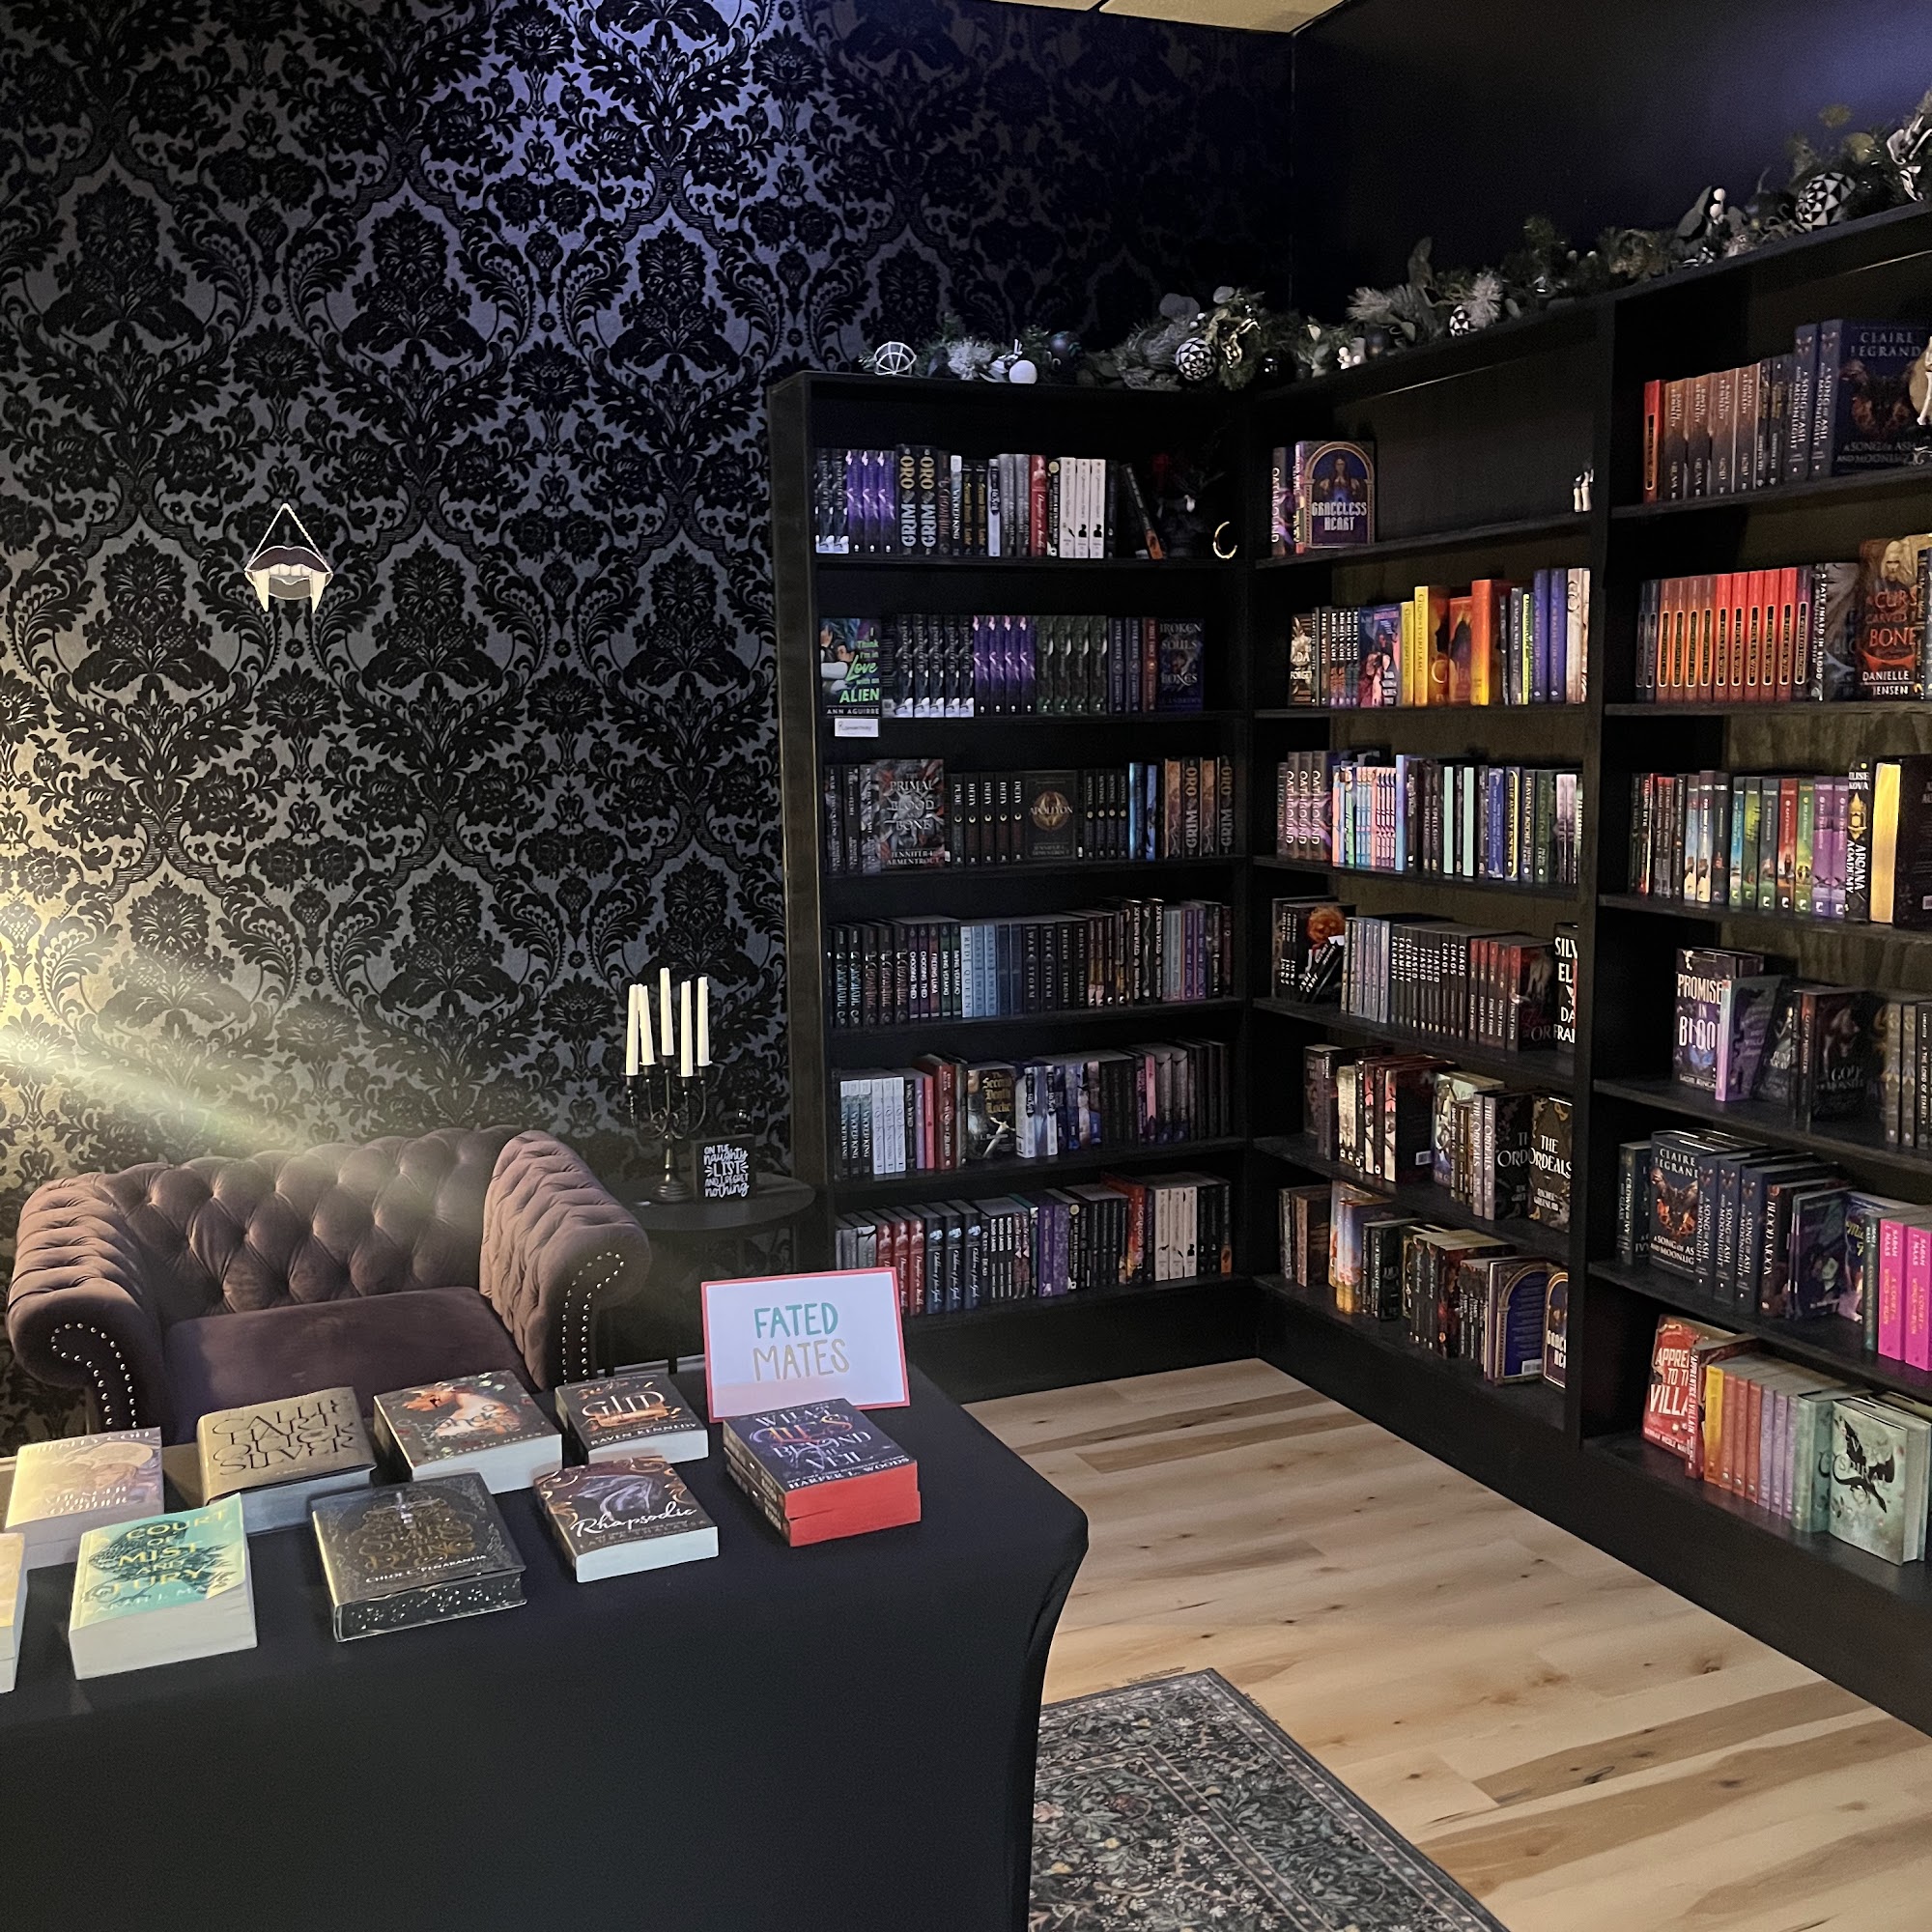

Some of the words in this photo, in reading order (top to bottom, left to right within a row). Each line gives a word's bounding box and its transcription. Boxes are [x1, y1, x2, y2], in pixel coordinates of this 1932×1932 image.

[899, 456, 915, 489] ORO
[920, 456, 935, 490] ORO
[1311, 501, 1367, 516] GRACELESS
[1324, 516, 1354, 530] HEART
[901, 503, 917, 547] GRIM
[921, 503, 937, 548] GRIM
[1870, 628, 1916, 647] BONE
[845, 654, 878, 681] Love
[1862, 670, 1909, 682] DANIELLE
[839, 688, 880, 703] ALIEN
[1873, 685, 1909, 696] JENSEN
[890, 781, 933, 791] PRIMAL
[1185, 767, 1198, 796] ORO
[1849, 781, 1869, 790] KOVA
[1286, 771, 1294, 844] OATHBOUND
[1298, 770, 1308, 844] OATHBOUND
[1311, 770, 1321, 845] OATHBOUND
[1185, 809, 1199, 848] GRIM
[1220, 809, 1233, 847] GRIM
[1854, 844, 1866, 890] ARCANA
[1555, 937, 1577, 958] SILV
[1677, 973, 1722, 1005] PROMISE
[1679, 1015, 1717, 1051] BLOO
[703, 1146, 715, 1154] ON
[1484, 1125, 1492, 1171] ORDEALS
[1541, 1134, 1559, 1154] THE
[1659, 1148, 1696, 1167] CLAIRE
[713, 1160, 741, 1177] LIST
[1529, 1148, 1572, 1179] ORDEALS
[704, 1181, 750, 1198] nothing
[1745, 1217, 1753, 1244] SONG
[1766, 1201, 1776, 1239] BLOOD
[1658, 1236, 1677, 1251] SONG
[1685, 1245, 1695, 1256] AS
[1717, 1208, 1725, 1267] MOONLIGHT
[1737, 1217, 1746, 1277] MOONLIGHT
[1660, 1246, 1694, 1265] MOONLIG
[1763, 1243, 1774, 1275] MOON
[753, 1302, 838, 1339] FATED
[753, 1338, 850, 1381] MATES
[1667, 1368, 1678, 1385] TO
[1690, 1355, 1698, 1398] APPRENTICE
[582, 1391, 666, 1417] GILD
[1649, 1383, 1689, 1416] VILLA
[213, 1400, 338, 1435] CALLIE
[755, 1405, 831, 1428] WHAT
[590, 1432, 633, 1446] RAVEN
[637, 1423, 696, 1435] KENNEDY
[772, 1431, 871, 1463] BEYOND
[219, 1436, 355, 1475] SILVER
[806, 1451, 862, 1471] VEIL
[788, 1472, 844, 1490] HARPER
[864, 1457, 910, 1472] WOODS
[127, 1510, 226, 1541] COURT
[570, 1501, 697, 1538] Rhapsodic
[119, 1542, 203, 1567] MIST
[136, 1559, 186, 1576] AND
[111, 1566, 206, 1592] FURY
[366, 1571, 403, 1583] CHLOE
